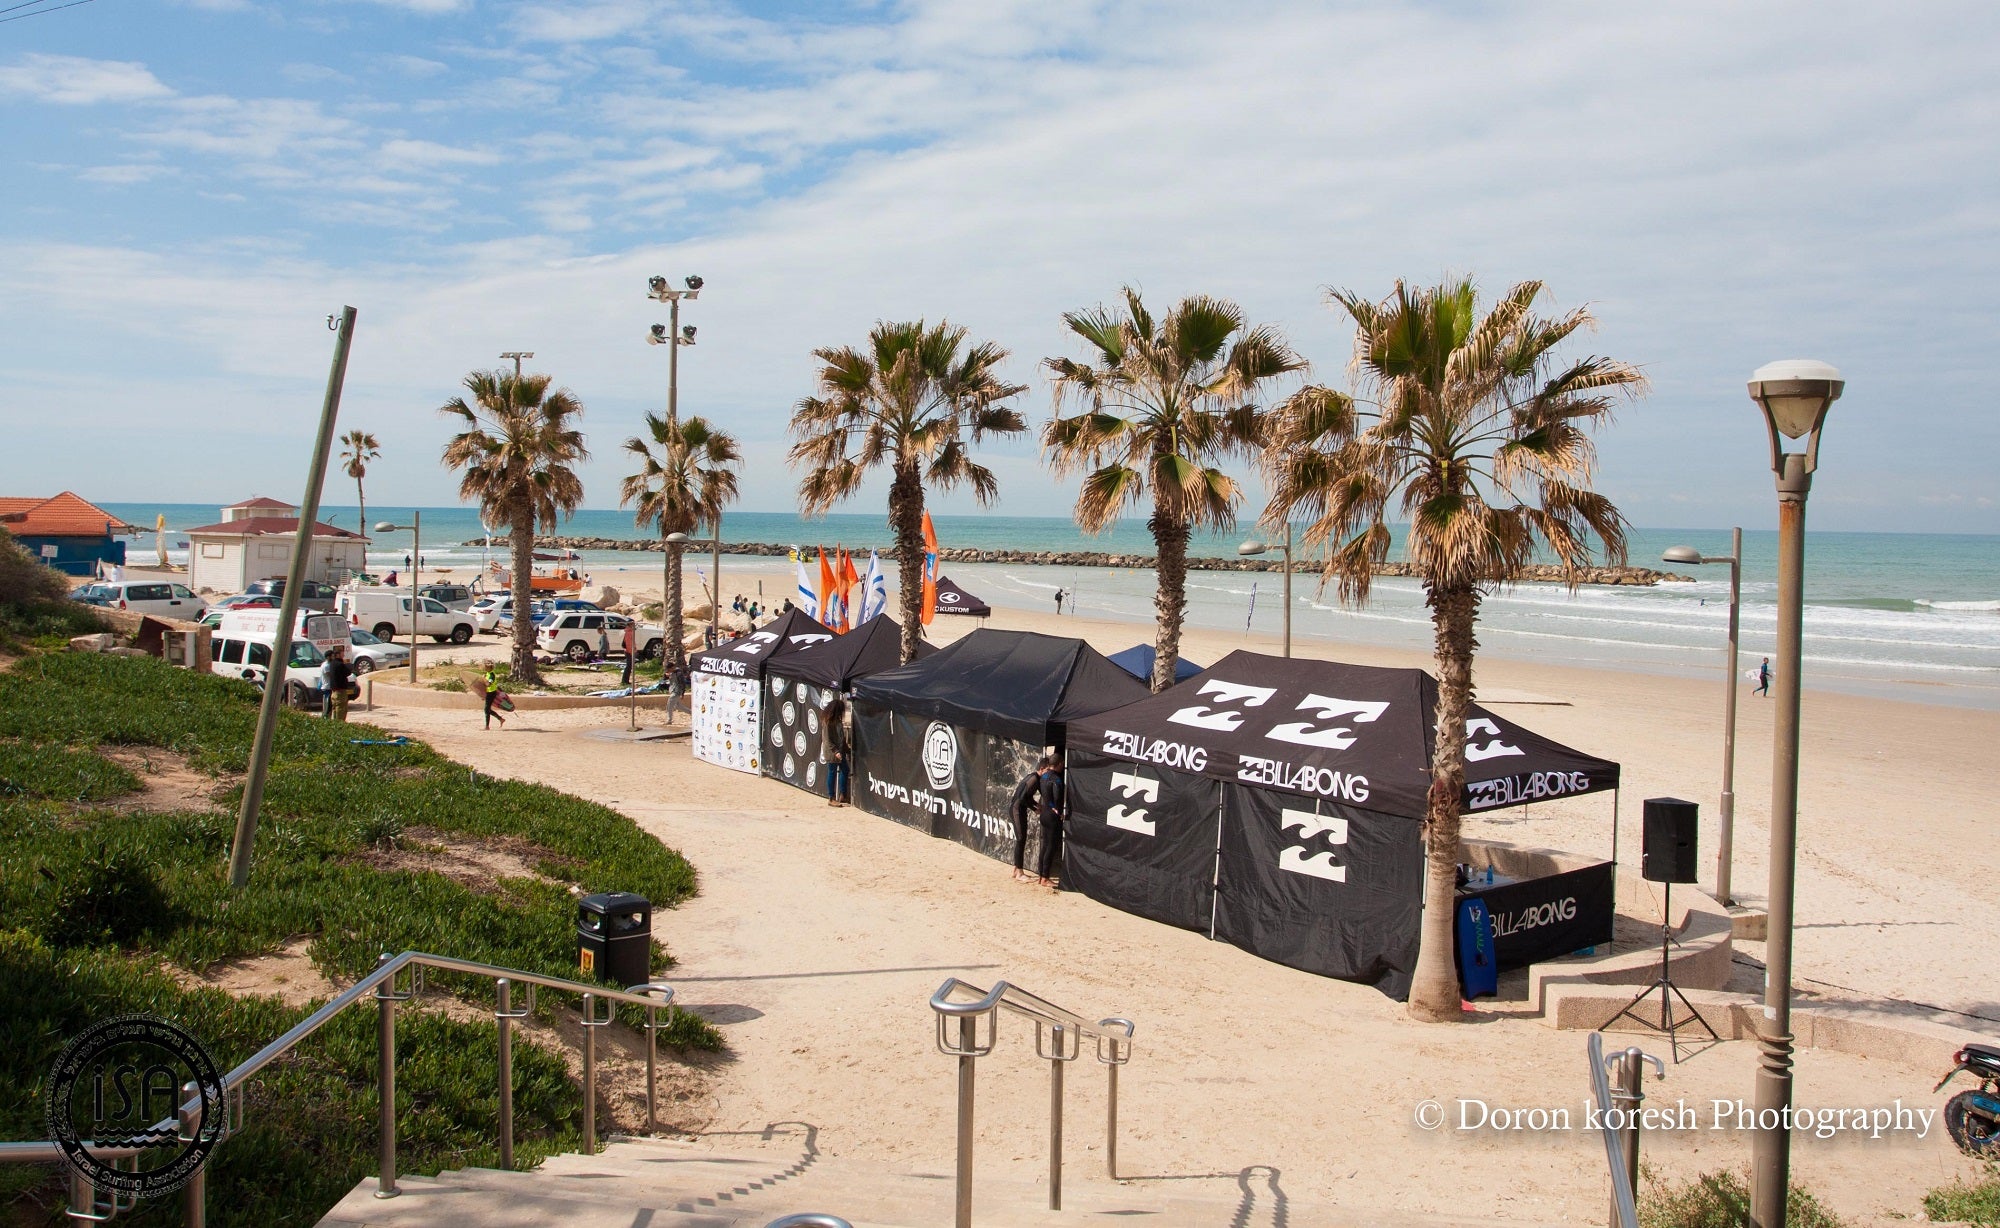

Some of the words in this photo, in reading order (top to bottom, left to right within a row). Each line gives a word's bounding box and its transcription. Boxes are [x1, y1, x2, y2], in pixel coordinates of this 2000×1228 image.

[316, 638, 345, 646] AMBULANCE
[707, 657, 747, 677] BILLABONG
[1122, 732, 1208, 772] BILLABONG
[868, 771, 910, 805] בישראל
[1262, 758, 1370, 803] BILLABONG
[1494, 771, 1590, 805] BILLABONG
[911, 788, 947, 816] הגלים
[950, 800, 981, 830] גולשי
[1488, 896, 1577, 939] BILLABONG
